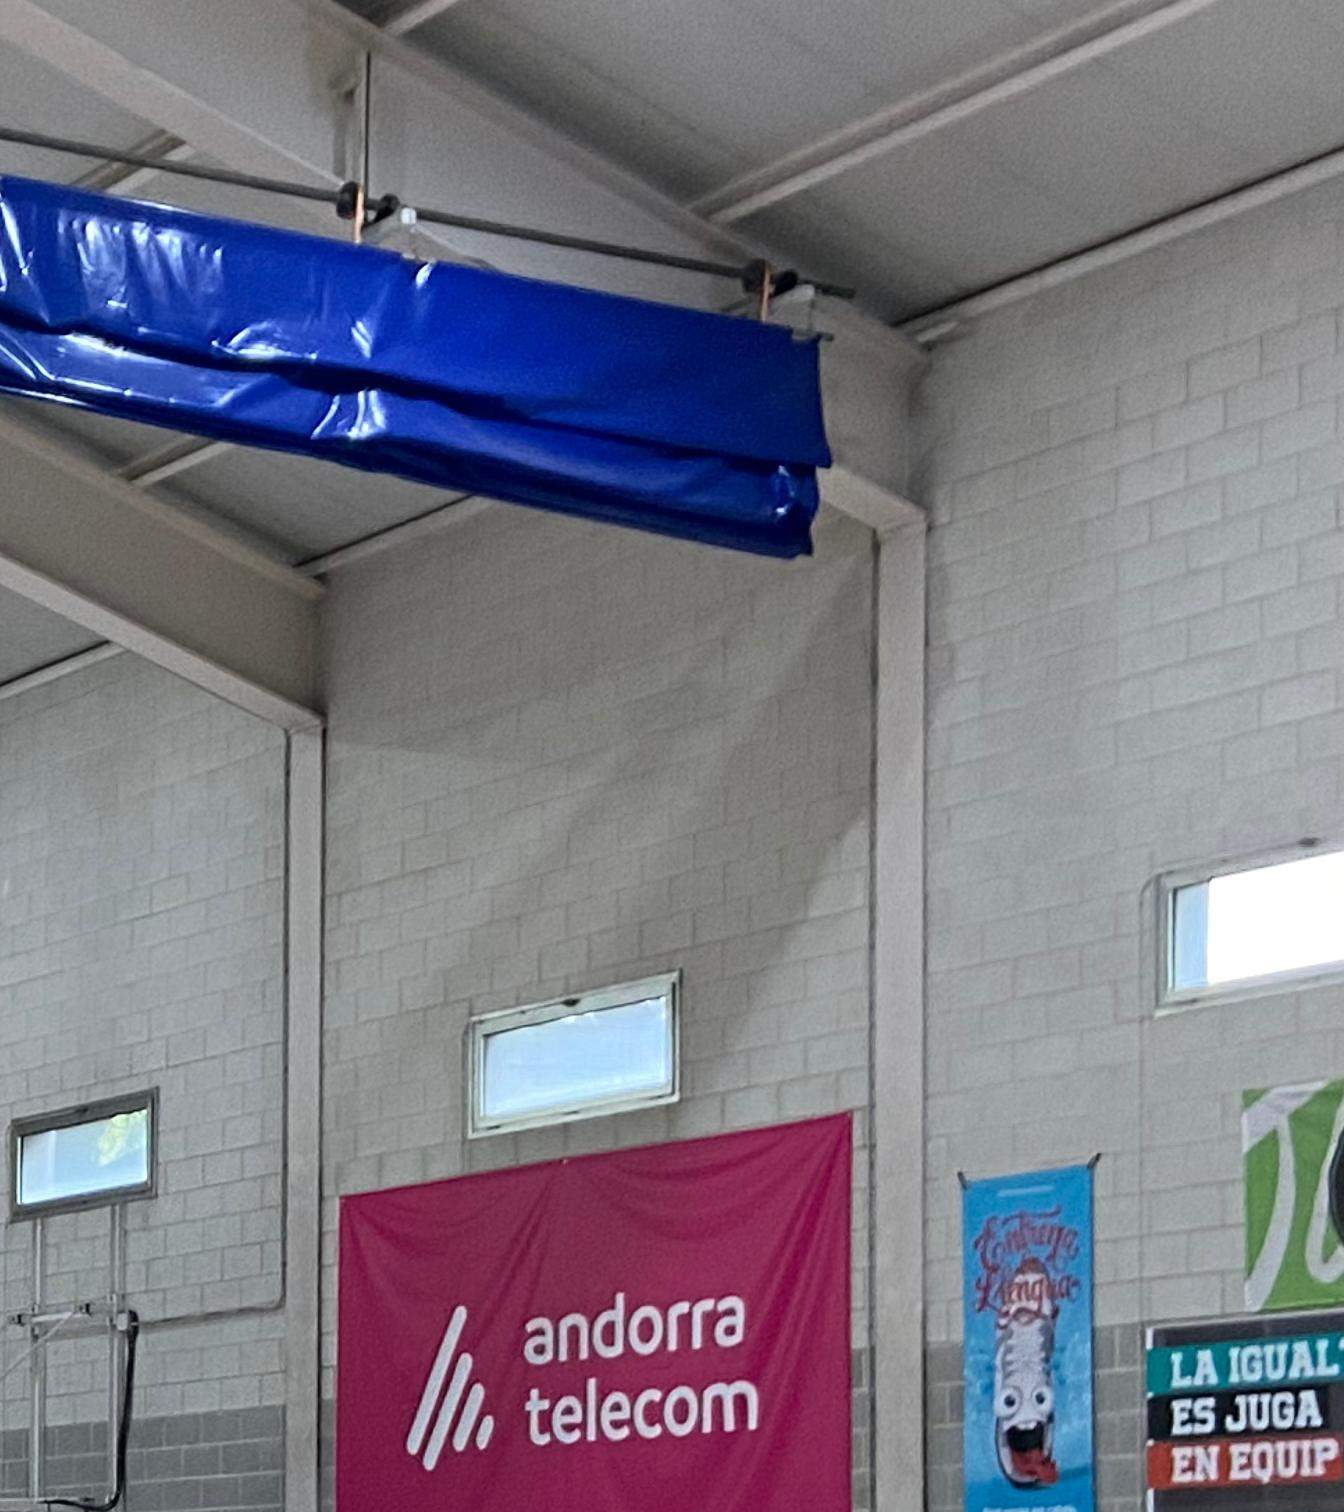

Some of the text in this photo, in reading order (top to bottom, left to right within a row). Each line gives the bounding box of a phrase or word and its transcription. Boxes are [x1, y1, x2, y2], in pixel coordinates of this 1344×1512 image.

[523, 1292, 746, 1365] andorra
[1170, 1338, 1344, 1388] LA IGUAL
[524, 1377, 760, 1446] telecom
[1170, 1389, 1324, 1436] ES JUGA
[1170, 1438, 1341, 1484] EN EQUIP
